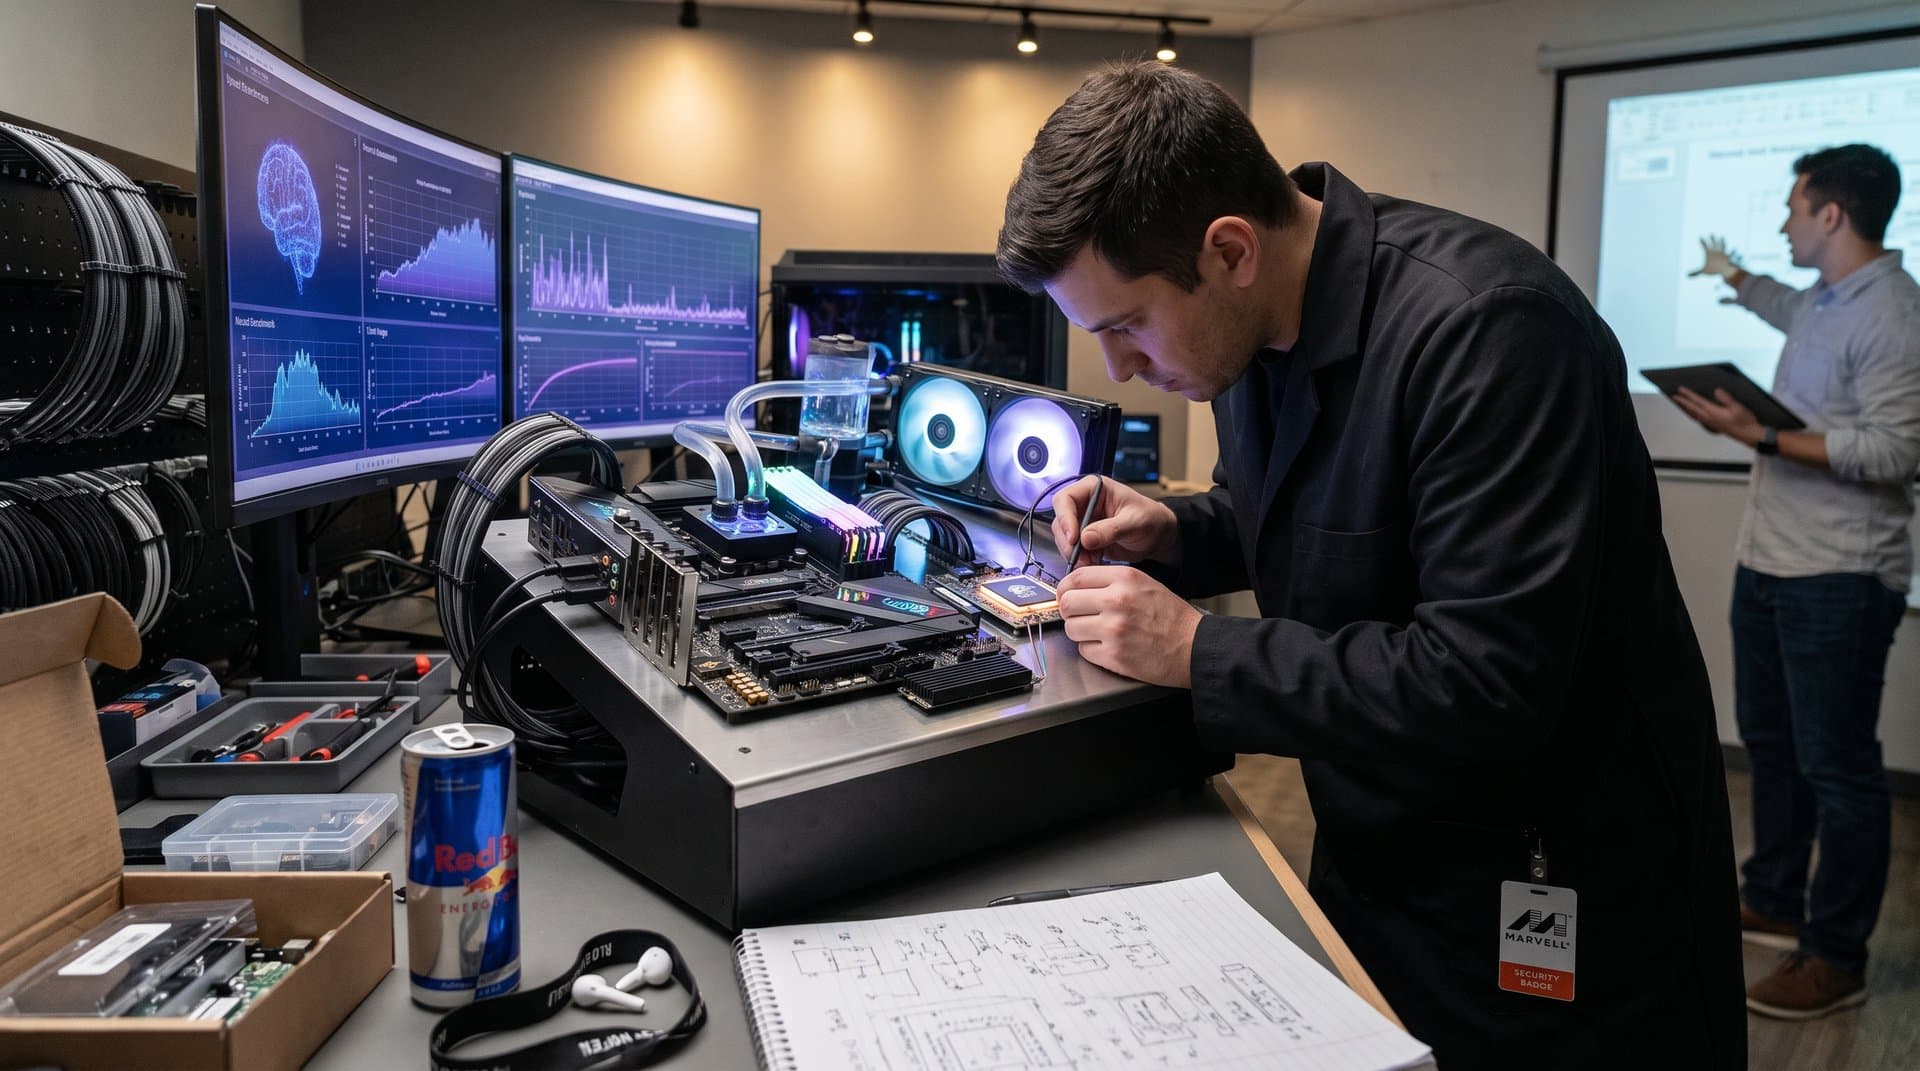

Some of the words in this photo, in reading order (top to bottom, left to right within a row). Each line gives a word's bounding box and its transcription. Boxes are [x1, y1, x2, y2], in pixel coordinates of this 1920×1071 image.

[434, 836, 496, 872] Red
[1514, 968, 1560, 982] SECURITY
[1520, 979, 1553, 991] BADGE
